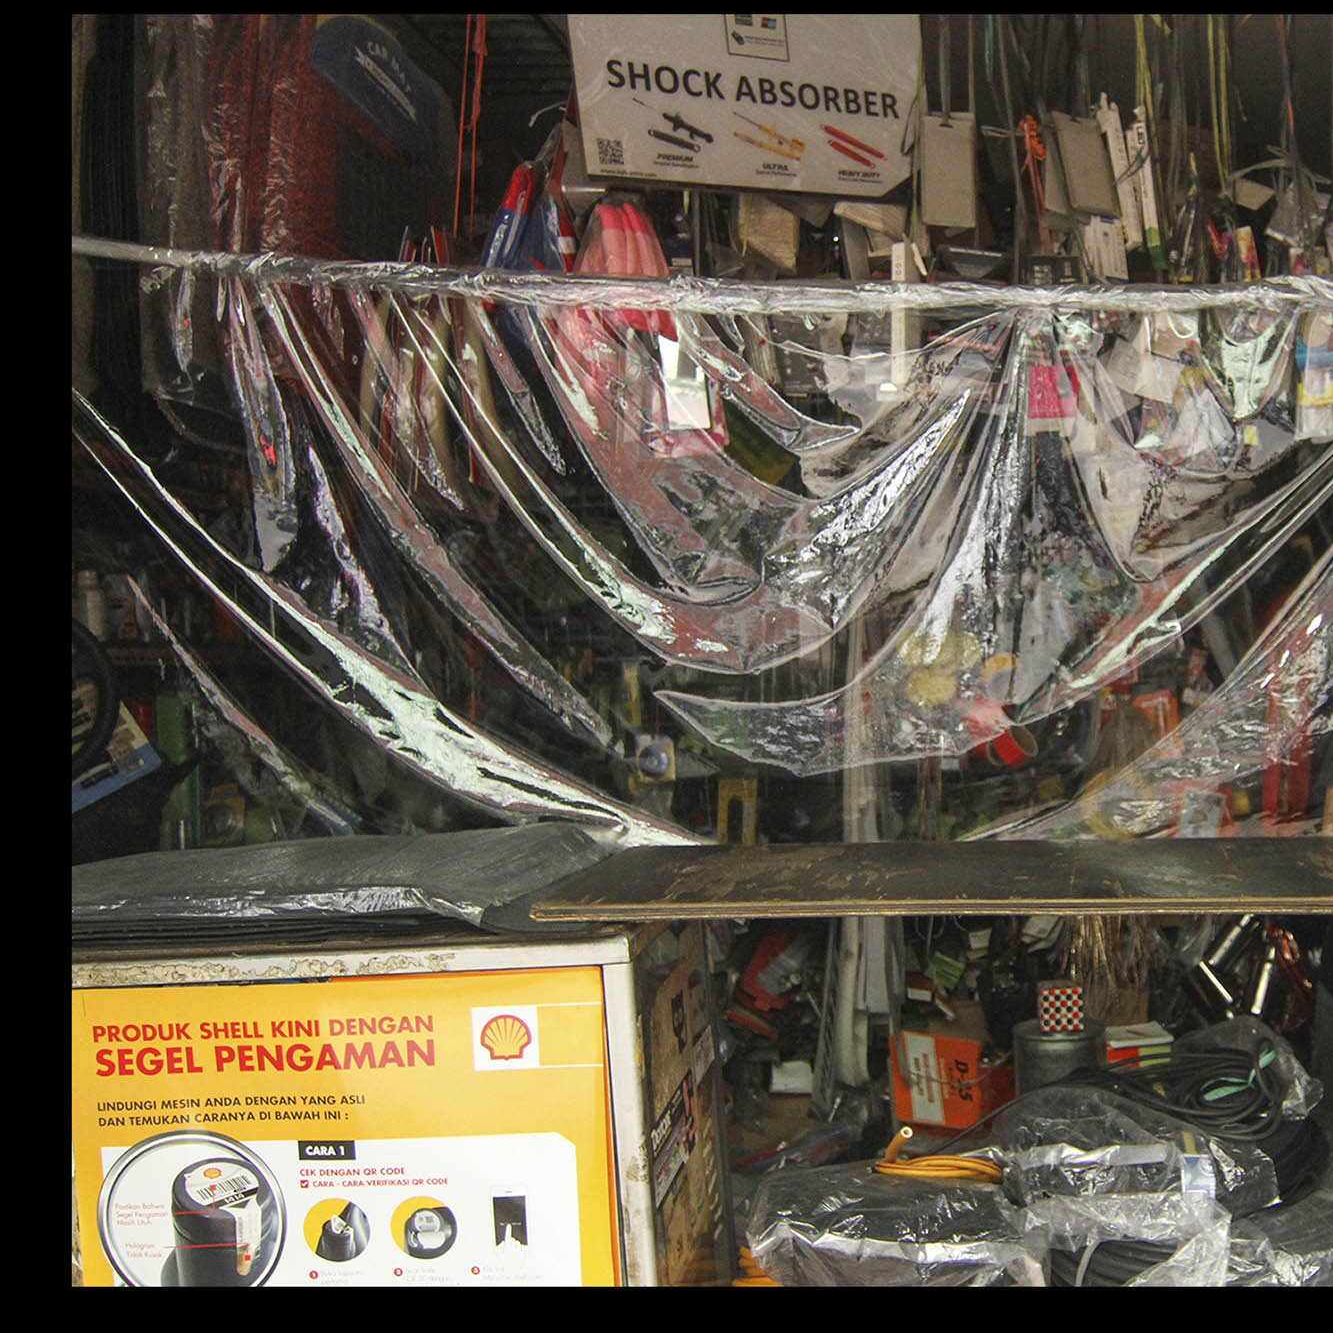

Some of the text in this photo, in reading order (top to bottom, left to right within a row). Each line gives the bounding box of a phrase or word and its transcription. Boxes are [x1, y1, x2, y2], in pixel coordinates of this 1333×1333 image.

[606, 59, 899, 119] SHOCK ABSORBER
[93, 1015, 434, 1043] PRODUK SHELL KINI DENGAN
[95, 1040, 436, 1077] SEGEL PENGAMAN
[97, 1093, 365, 1112] LINDUNGI MESIN ANDA DENGAN YANG ASLI
[306, 1146, 345, 1156] CARA 1
